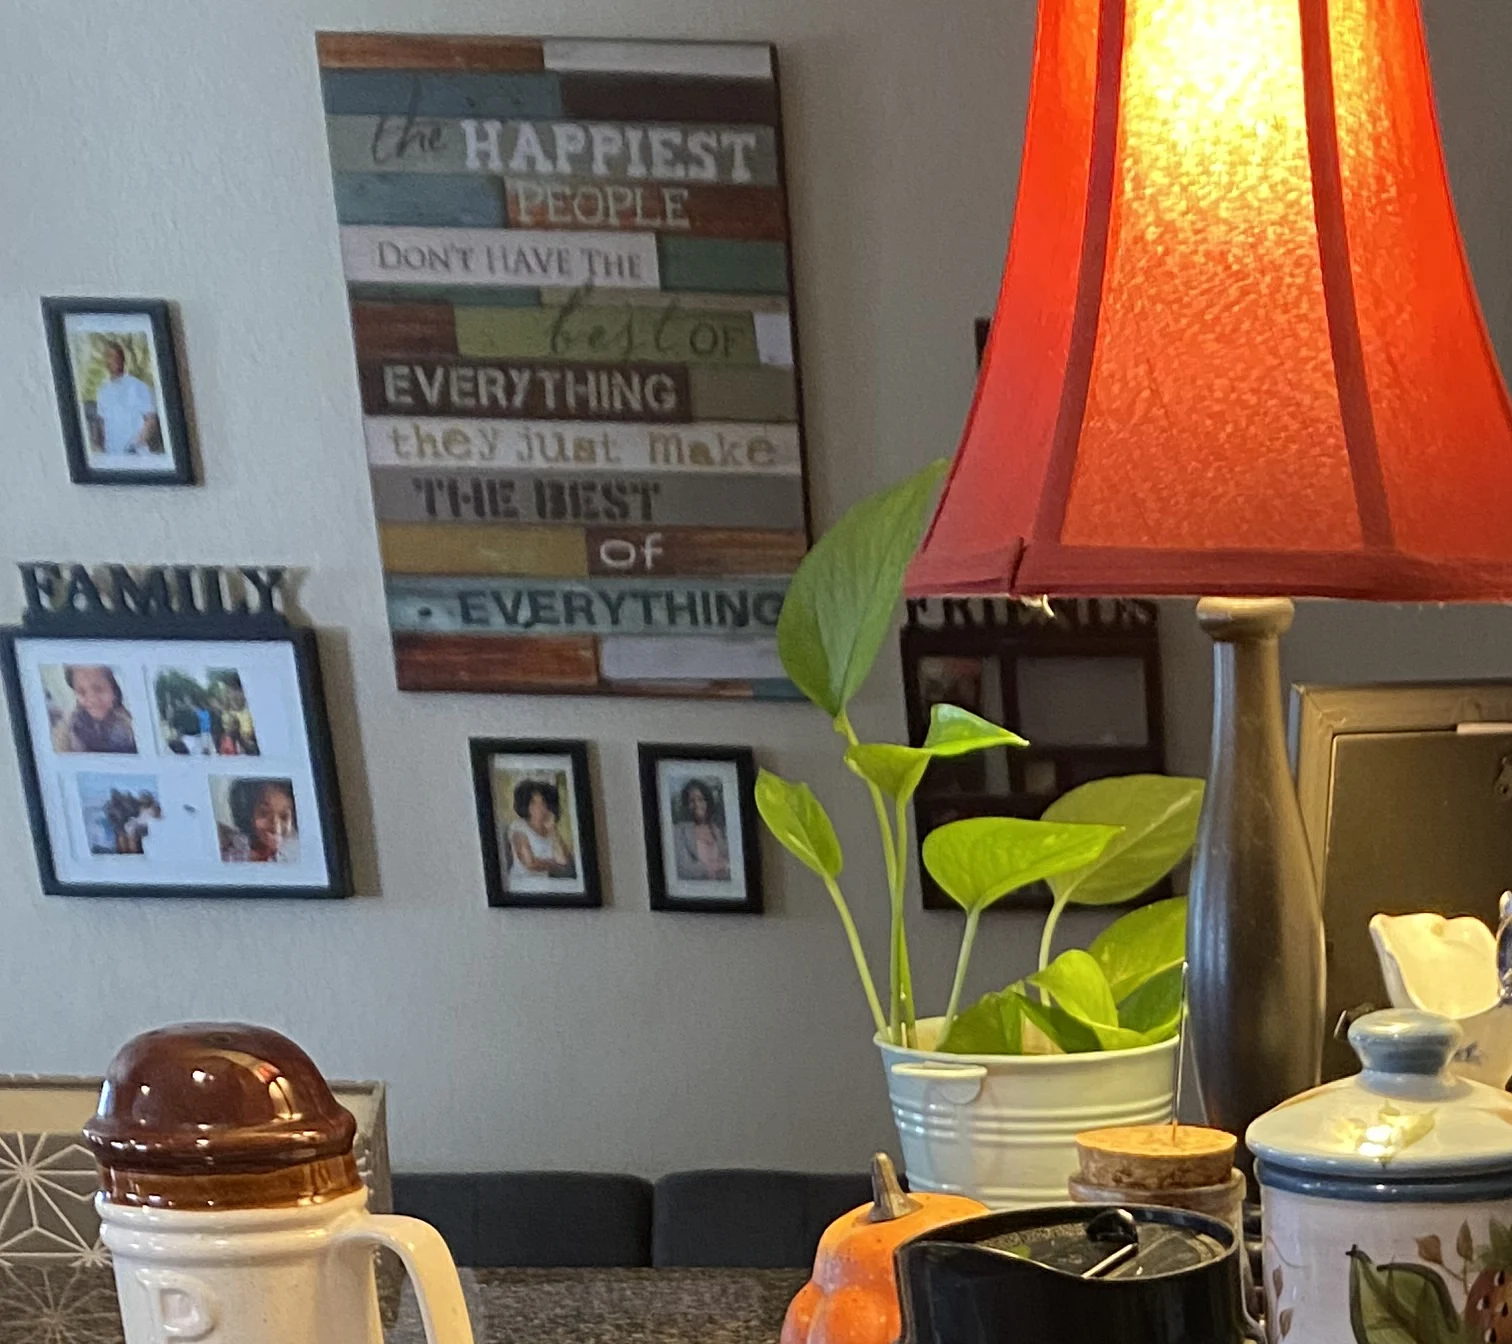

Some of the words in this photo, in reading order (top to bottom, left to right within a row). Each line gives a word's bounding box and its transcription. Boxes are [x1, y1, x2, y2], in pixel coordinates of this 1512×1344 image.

[460, 118, 756, 183] HAPPIEST
[515, 178, 691, 229] PEOPLE
[377, 240, 473, 271] DON'T
[486, 245, 570, 277] HAVE
[580, 247, 642, 280] THE
[549, 279, 679, 363] best
[689, 320, 745, 358] OF
[383, 364, 677, 414] EVERYTHING
[387, 423, 502, 463] they
[515, 429, 622, 463] just
[648, 430, 778, 467] make
[412, 477, 520, 521] THE
[534, 479, 661, 522] BEST
[16, 561, 290, 613] FAMILY
[457, 589, 785, 630] EVERYTHING
